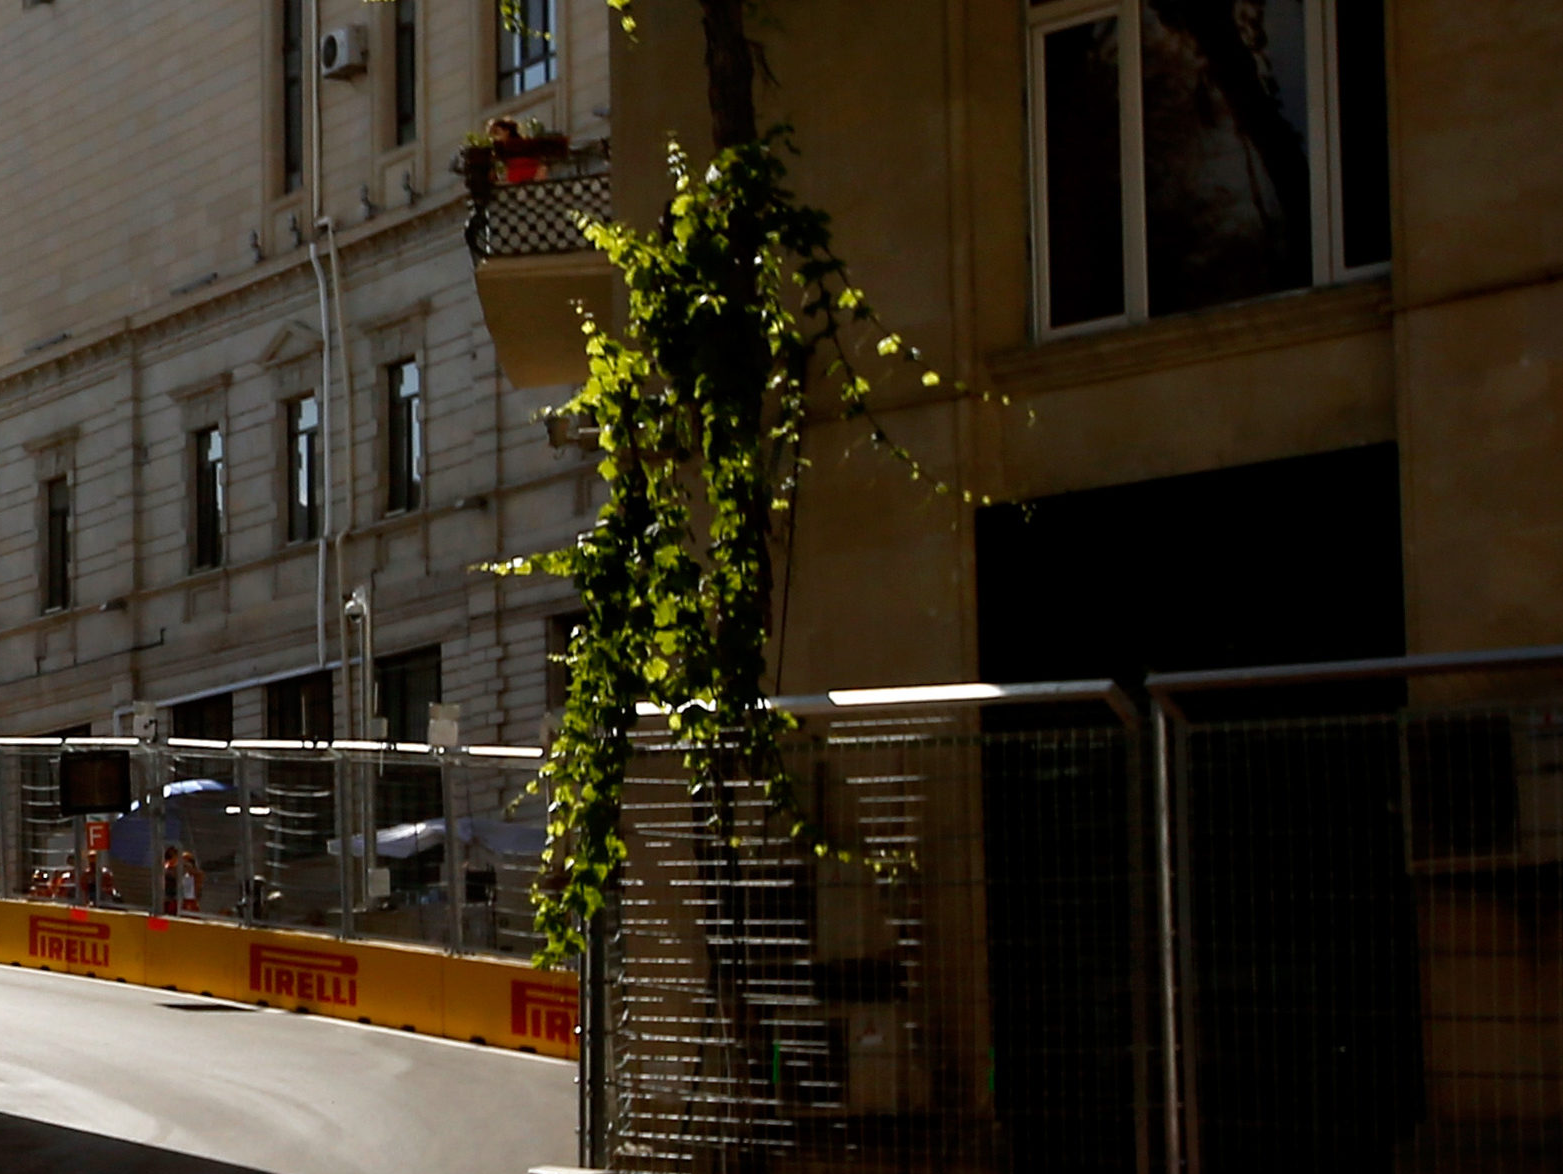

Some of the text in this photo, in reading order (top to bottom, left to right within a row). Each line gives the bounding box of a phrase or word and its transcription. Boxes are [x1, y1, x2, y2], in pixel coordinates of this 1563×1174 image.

[89, 825, 104, 847] F
[29, 914, 110, 968] PIRELLI
[250, 943, 358, 1006] PIRELLI
